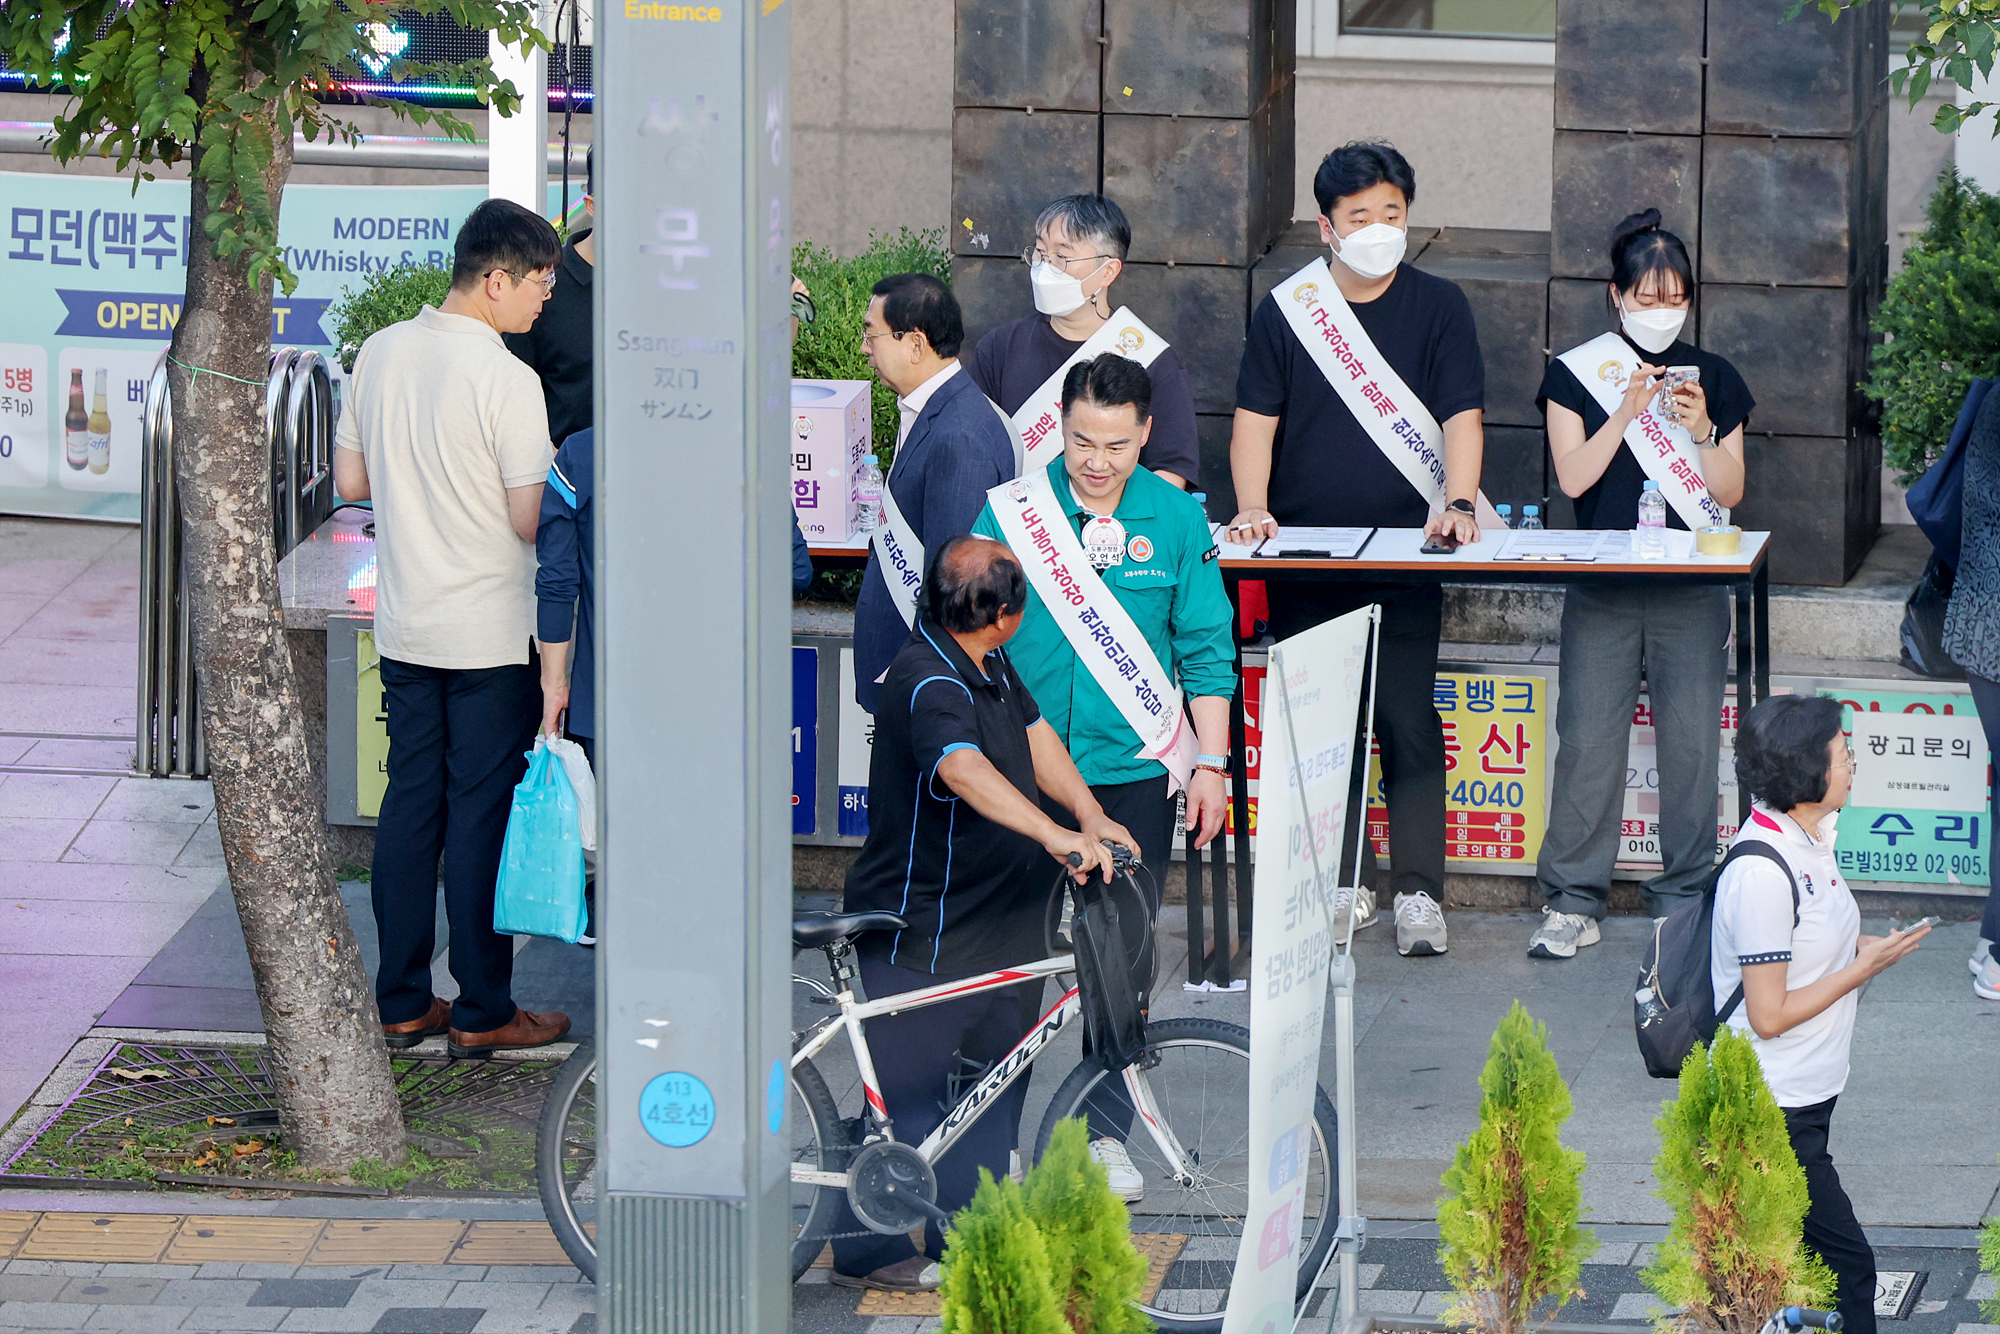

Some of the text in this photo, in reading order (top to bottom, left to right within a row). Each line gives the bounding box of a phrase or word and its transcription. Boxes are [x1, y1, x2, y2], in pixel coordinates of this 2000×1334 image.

[624, 0, 722, 22] Entrance
[333, 217, 449, 240] MODERN
[97, 301, 181, 331] OPEN
[1311, 307, 1367, 381] 구청장과
[1360, 380, 1398, 418] 함께
[5, 368, 33, 393] 5병
[654, 367, 699, 390] 双门
[641, 399, 713, 421] サンムン
[1021, 412, 1057, 451] 함께
[1668, 457, 1706, 494] 함께
[1021, 507, 1163, 717] 도봉구청장 현장민원 상담
[1867, 735, 1971, 760] 광고문의
[1869, 813, 1979, 849] 수리
[1835, 850, 1918, 874] 르빌319호
[663, 1081, 690, 1096] 413
[647, 1102, 709, 1126] 4호선
